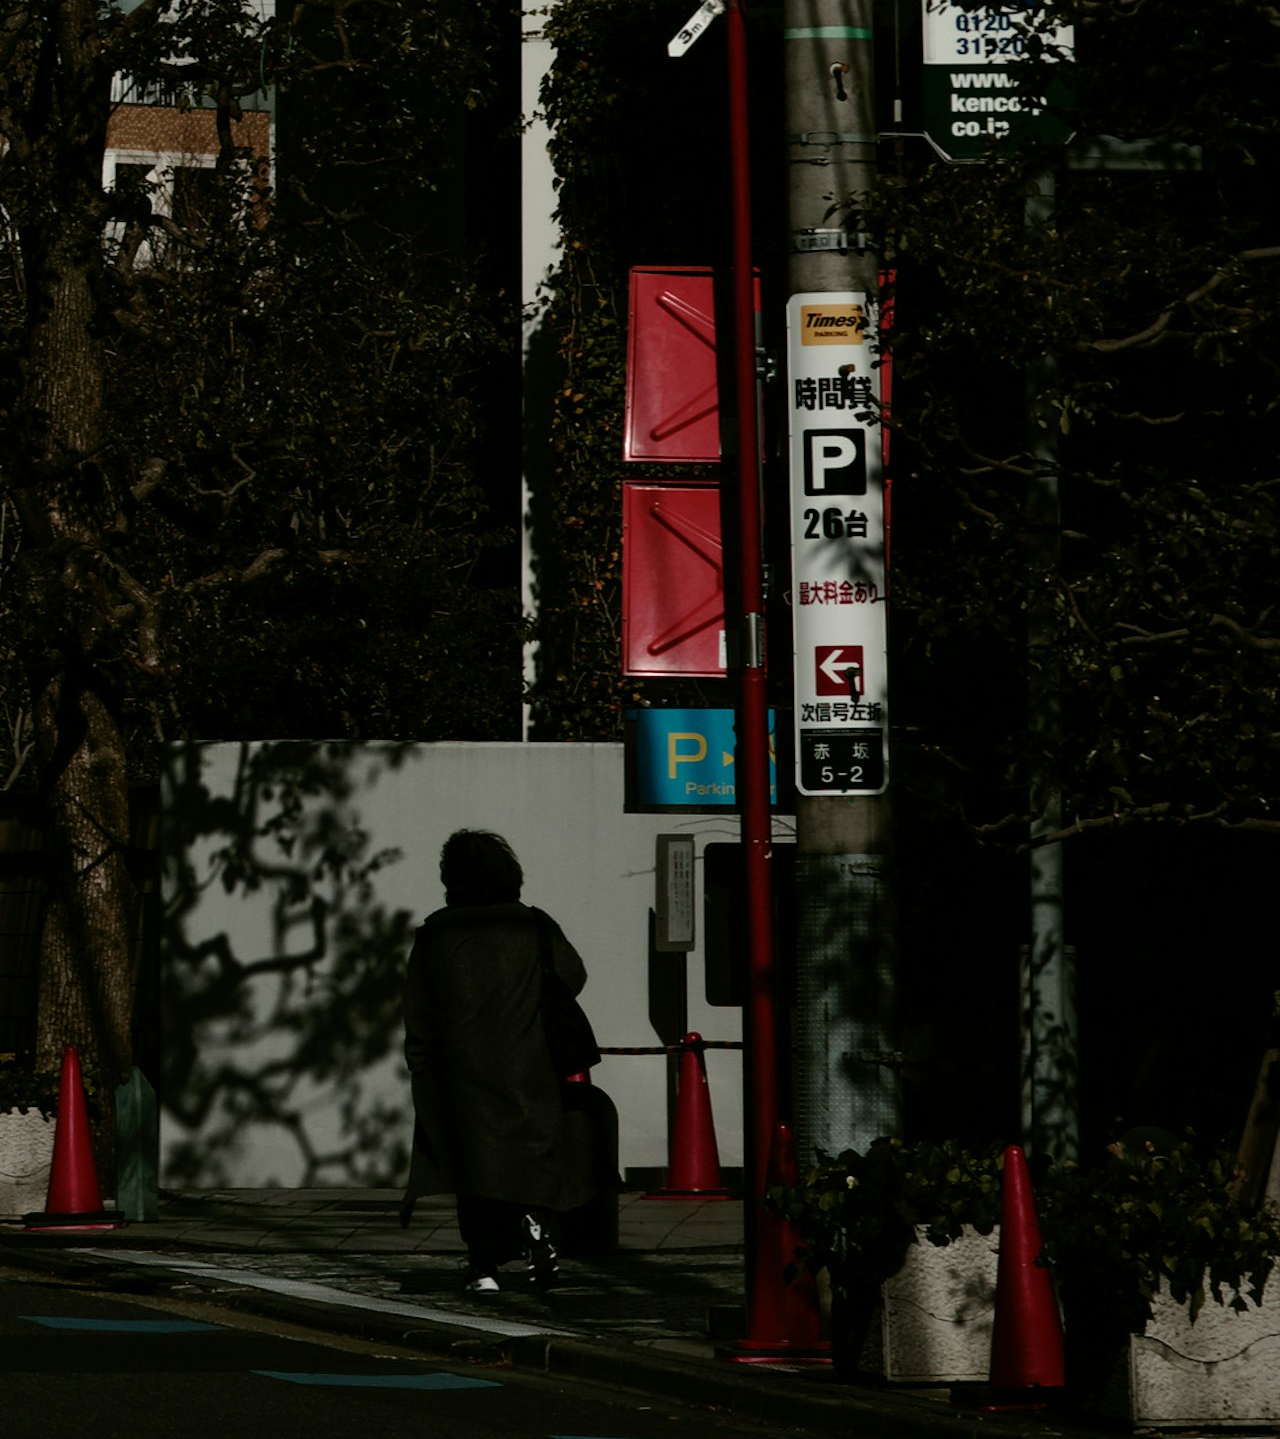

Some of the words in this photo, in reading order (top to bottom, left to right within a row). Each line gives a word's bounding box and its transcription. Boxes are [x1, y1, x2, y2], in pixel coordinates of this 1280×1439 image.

[806, 312, 857, 328] Times
[795, 377, 872, 411] 時間貸
[811, 435, 857, 490] P
[804, 507, 868, 540] 26台
[800, 581, 879, 606] 最大料金あり
[801, 702, 882, 722] 次信号左折
[668, 732, 708, 780] P
[820, 766, 864, 783] 5-2
